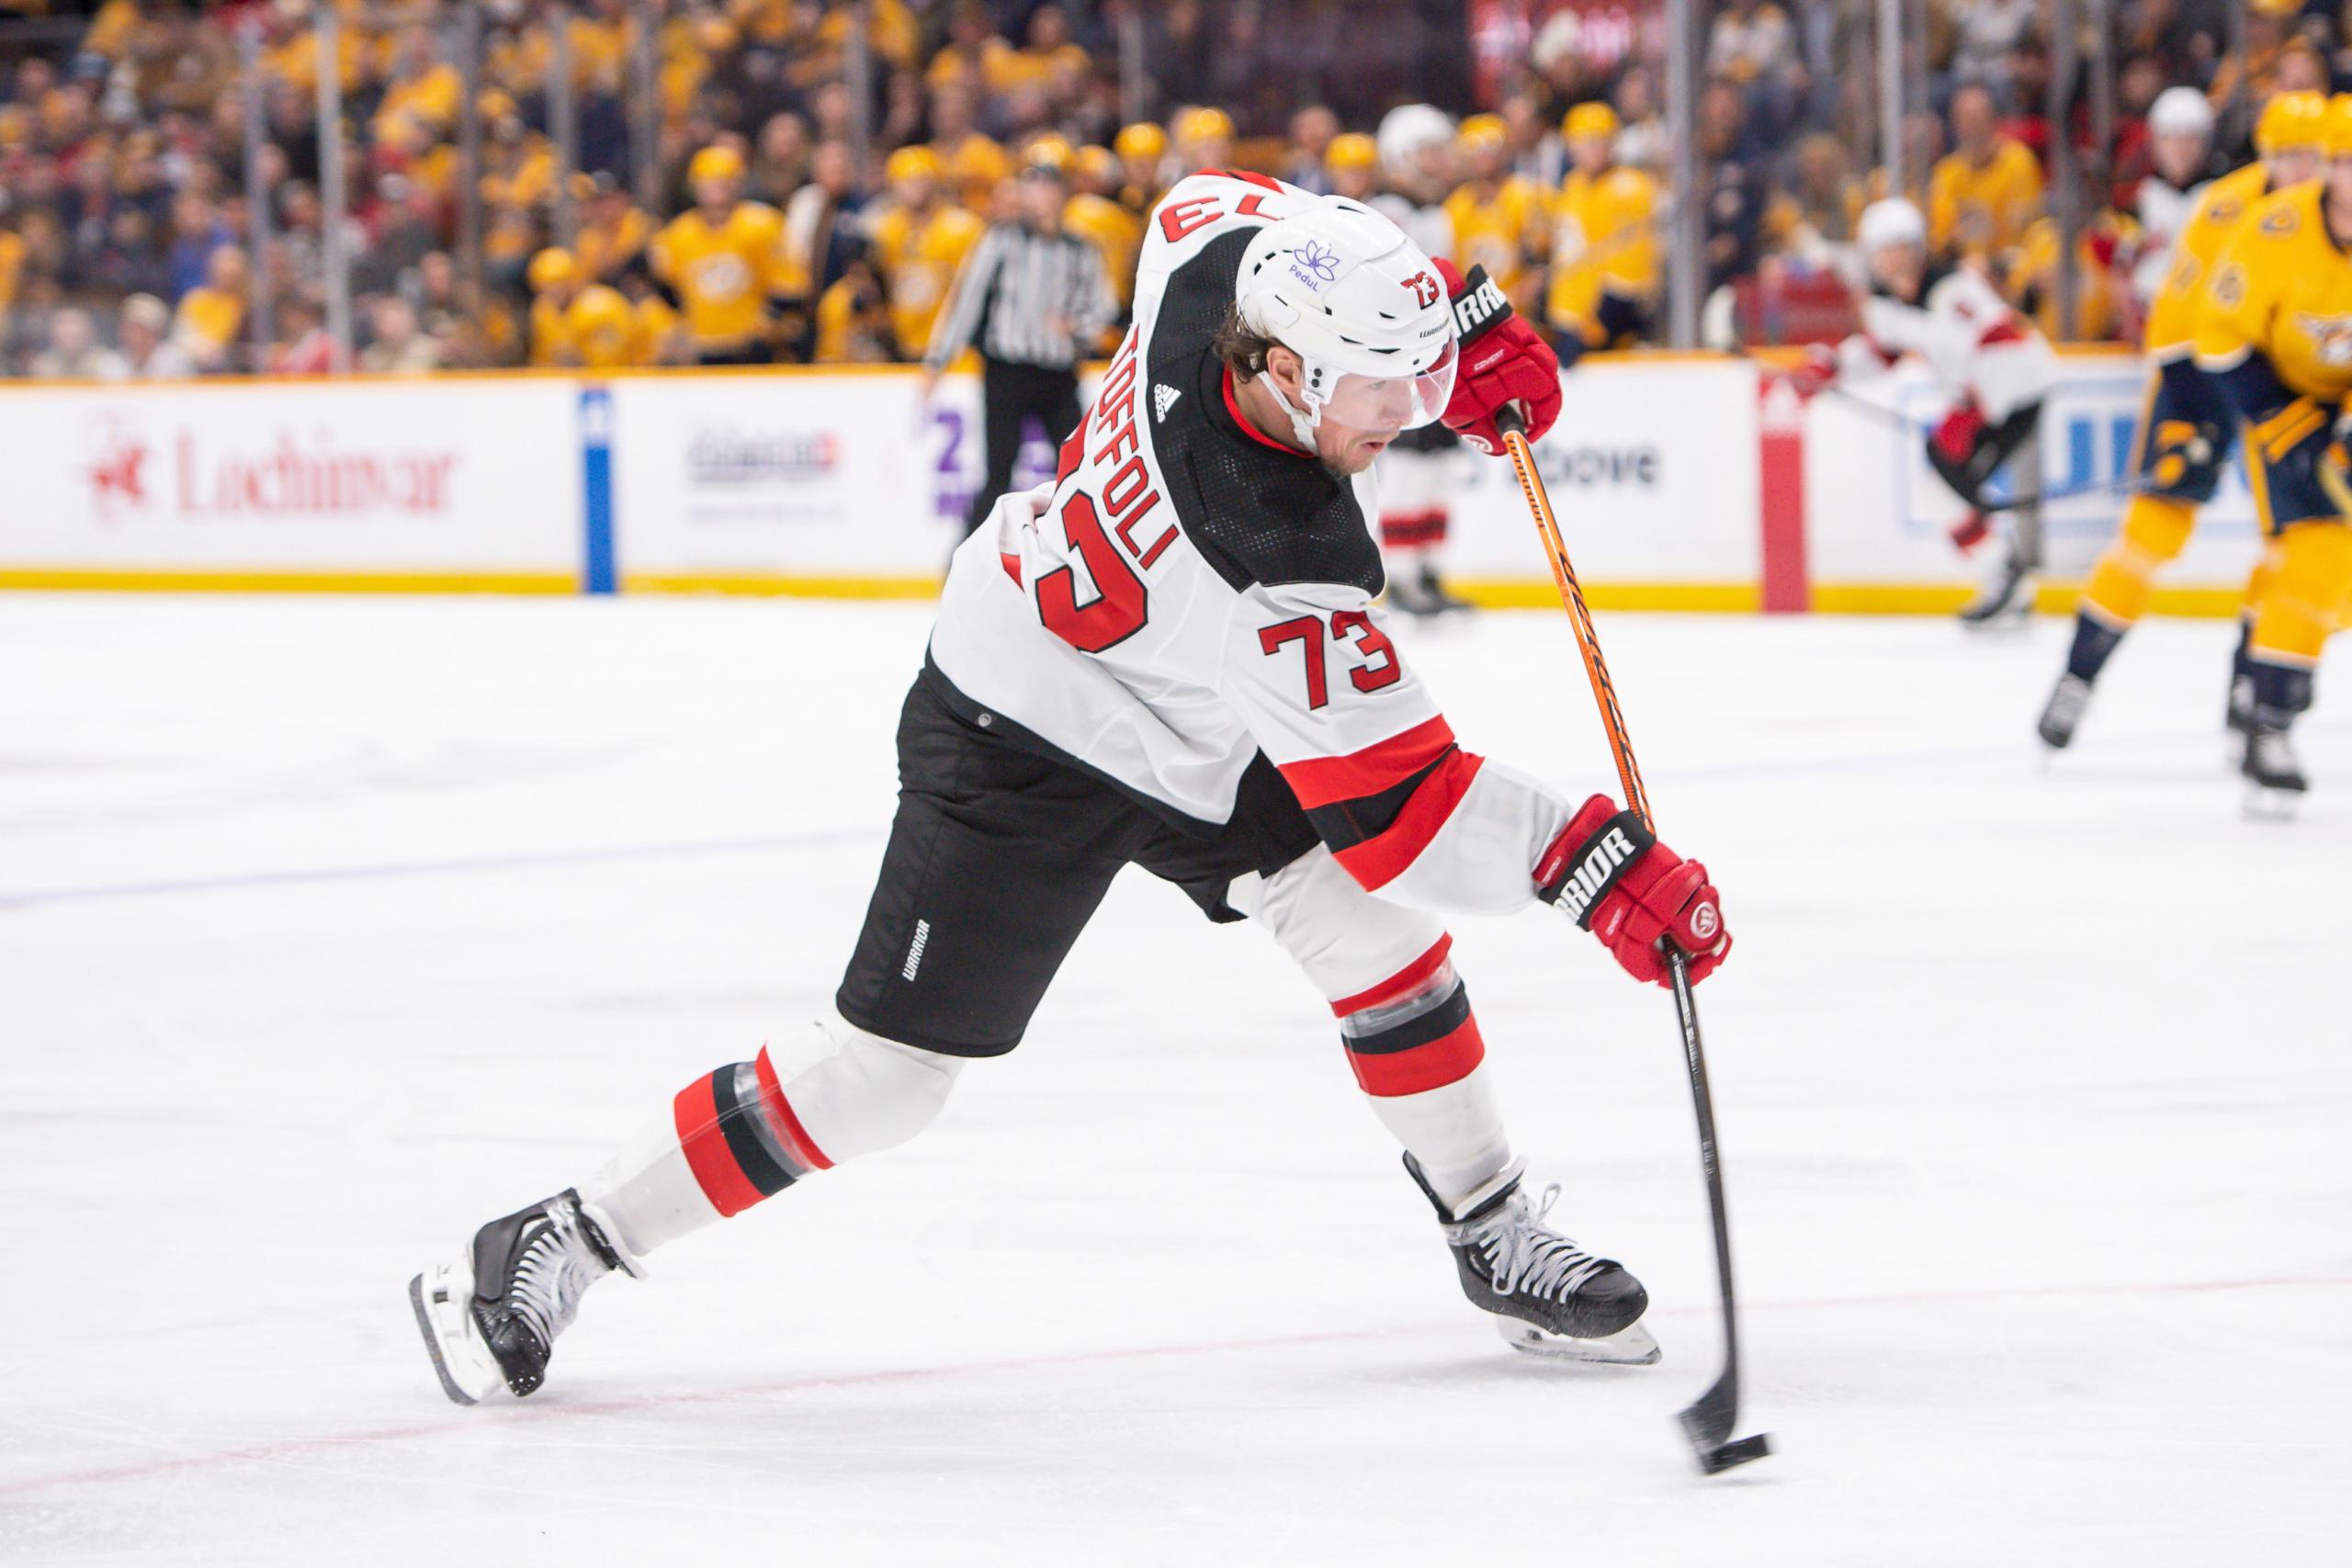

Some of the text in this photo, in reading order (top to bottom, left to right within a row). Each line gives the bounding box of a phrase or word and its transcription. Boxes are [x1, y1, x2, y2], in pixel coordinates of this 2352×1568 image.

[1400, 270, 1440, 310] 73
[1093, 322, 1180, 571] TOFFOLI
[1257, 610, 1401, 711] 73
[901, 919, 931, 982] WARRIOR
